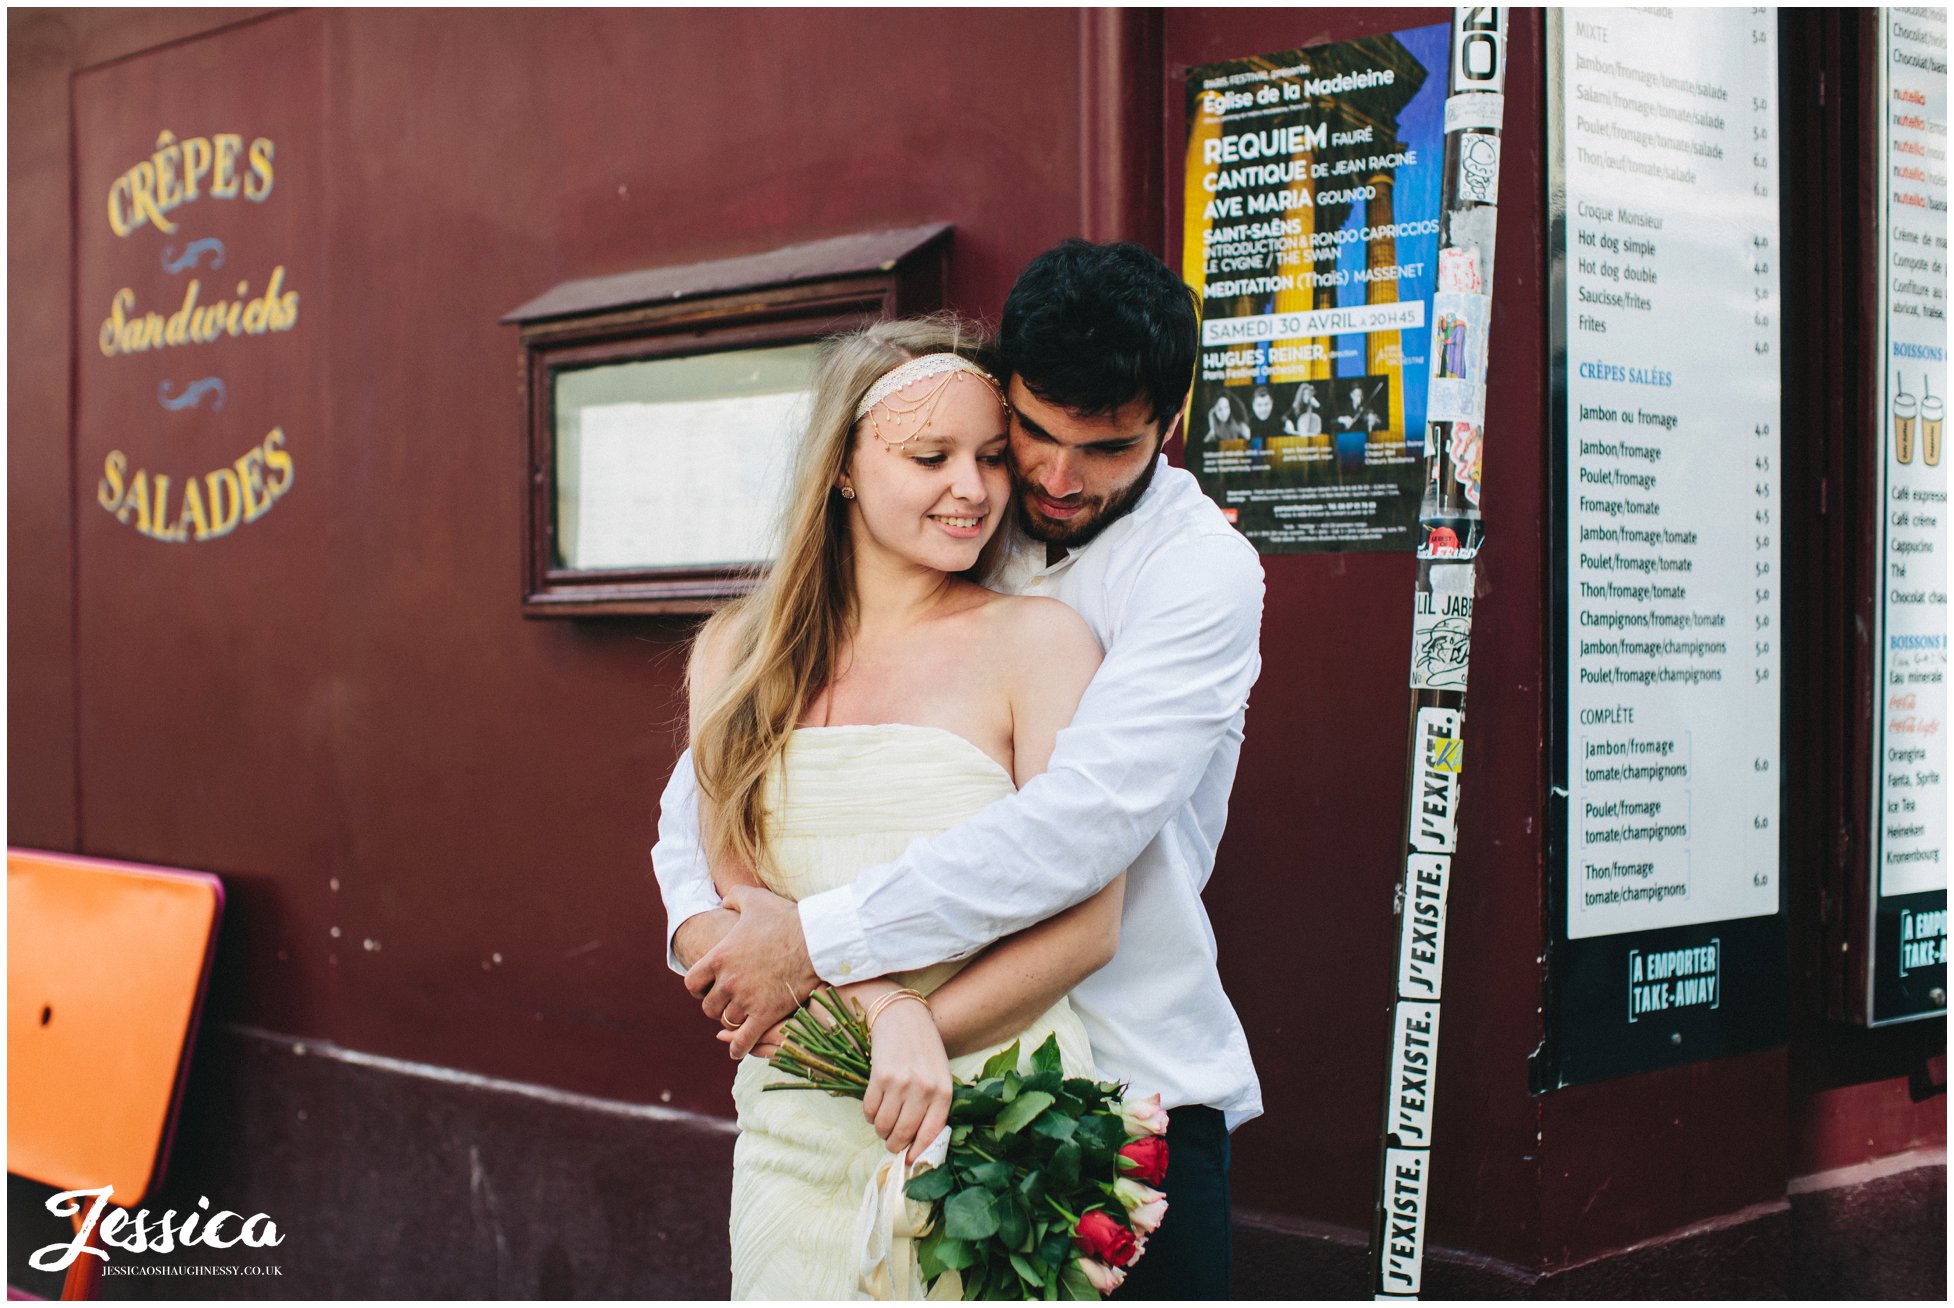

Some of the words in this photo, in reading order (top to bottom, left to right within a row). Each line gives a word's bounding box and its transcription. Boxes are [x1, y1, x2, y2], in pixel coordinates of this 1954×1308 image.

[1576, 21, 1608, 44] MIXTE
[1752, 30, 1767, 44] 5.0
[1203, 90, 1254, 115] Église
[1256, 85, 1280, 104] de
[1283, 82, 1301, 100] la
[1304, 68, 1395, 98] Madeleine
[1576, 52, 1728, 101] Jambon/fromage/tomate/salade
[1753, 97, 1767, 111] 5.0
[1576, 84, 1725, 130] Salami/fromage/tomate/salade
[1753, 126, 1767, 141] 5.0
[1204, 122, 1328, 165] REQUIEM
[1331, 125, 1373, 147] FAURÉ
[1577, 116, 1723, 160] Poulet/fromage/tomate/salade
[1753, 155, 1768, 169] 6.0
[108, 129, 275, 237] CRÊPES
[1203, 160, 1307, 193] CANTIQUE
[1310, 164, 1329, 179] DE
[1331, 158, 1366, 176] JEAN
[1368, 151, 1417, 170] RACINE
[1203, 196, 1243, 220] AVE
[1248, 188, 1314, 215] MARIA
[1316, 185, 1376, 206] GOUNOD
[1754, 183, 1768, 197] 6.0
[1202, 218, 1302, 244] SAINT-SAËNS
[1578, 200, 1613, 223] Croque
[1618, 208, 1663, 230] Monsieur
[1754, 235, 1768, 249] 4.0
[1203, 235, 1299, 259] INTRODUCTION
[1310, 230, 1358, 246] RONDO
[1578, 229, 1596, 247] Hot
[1600, 231, 1619, 254] dog
[1624, 235, 1656, 257] simple
[1754, 262, 1768, 275] 4.0
[1203, 259, 1218, 274] LE
[1221, 255, 1263, 273] CYGNE
[1276, 250, 1300, 265] THE
[1302, 247, 1342, 263] SWAN
[1202, 275, 1293, 299] MEDITATION
[1353, 262, 1425, 283] MASSENET
[1578, 257, 1596, 275] Hot
[1600, 260, 1619, 282] dog
[1624, 263, 1657, 284] double
[1754, 287, 1769, 301] 5.0
[1578, 286, 1651, 311] Saucisse/frites
[1754, 313, 1769, 327] 6.0
[1209, 322, 1273, 341] SAMEDI
[1279, 317, 1301, 334] 30
[1307, 313, 1356, 330] AVRIL
[1579, 314, 1607, 333] Frites
[1754, 342, 1769, 355] 4.0
[1202, 349, 1265, 369] HUGUES
[1268, 344, 1327, 364] REINER,
[1893, 341, 1943, 362] BOISSONS
[1579, 359, 1625, 383] CRÊPES
[1629, 365, 1672, 387] SALÉES
[1579, 404, 1617, 422] Jambon
[1621, 411, 1634, 424] ou
[1638, 408, 1678, 430] fromage
[1755, 424, 1769, 438] 4.0
[1579, 439, 1661, 463] Jambon/fromage
[1755, 457, 1770, 472] 4.5
[98, 426, 294, 543] SALADES
[1580, 467, 1656, 490] Poulet/fromage
[1755, 483, 1770, 498] 4.5
[1580, 496, 1660, 516] Fromage/tomate
[1755, 509, 1770, 524] 4.5
[1580, 525, 1697, 546] Jambon/fromage/tomate
[1755, 536, 1770, 550] 5.0
[1580, 553, 1693, 573] Poulet/fromage/tomate
[1755, 562, 1770, 577] 5.0
[1418, 594, 1436, 615] LIL
[1580, 582, 1686, 602] Thon/fromage/tomate
[1755, 589, 1770, 604] 5.0
[1580, 610, 1725, 630] Champignons/fromage/tomate
[1755, 615, 1770, 630] 5.0
[1580, 639, 1727, 659] Jambon/fromage/champignons
[1755, 642, 1770, 657] 5.0
[1890, 635, 1940, 650] BOISSONS
[1580, 667, 1722, 686] Poulet/fromage/champignons
[1755, 668, 1770, 684] 5.0
[1580, 704, 1634, 725] COMPLÈTE
[1585, 738, 1674, 759] Jambon/fromage
[1754, 757, 1769, 772] 6.0
[1888, 747, 1926, 765] Orangina
[1585, 762, 1687, 782] tomate/champignons
[1585, 800, 1661, 819] Poulet/fromage
[1754, 815, 1768, 829] 6.0
[1585, 823, 1687, 844] tomate/champignons
[1887, 823, 1924, 839] Heineken
[1887, 848, 1940, 865] Kronenbourg
[1585, 860, 1654, 880] Thon/fromage
[1753, 873, 1768, 887] 6.0
[1585, 883, 1686, 906] tomate/champignons
[1409, 863, 1442, 994] J'EXISTE.
[1904, 914, 1914, 940] A
[1633, 955, 1643, 983] A
[1647, 946, 1716, 981] EMPORTER
[1633, 975, 1716, 1014] TAKE-AWAY
[1399, 1011, 1432, 1140] J'EXISTE.
[1388, 1159, 1421, 1287] J'EXISTE.
